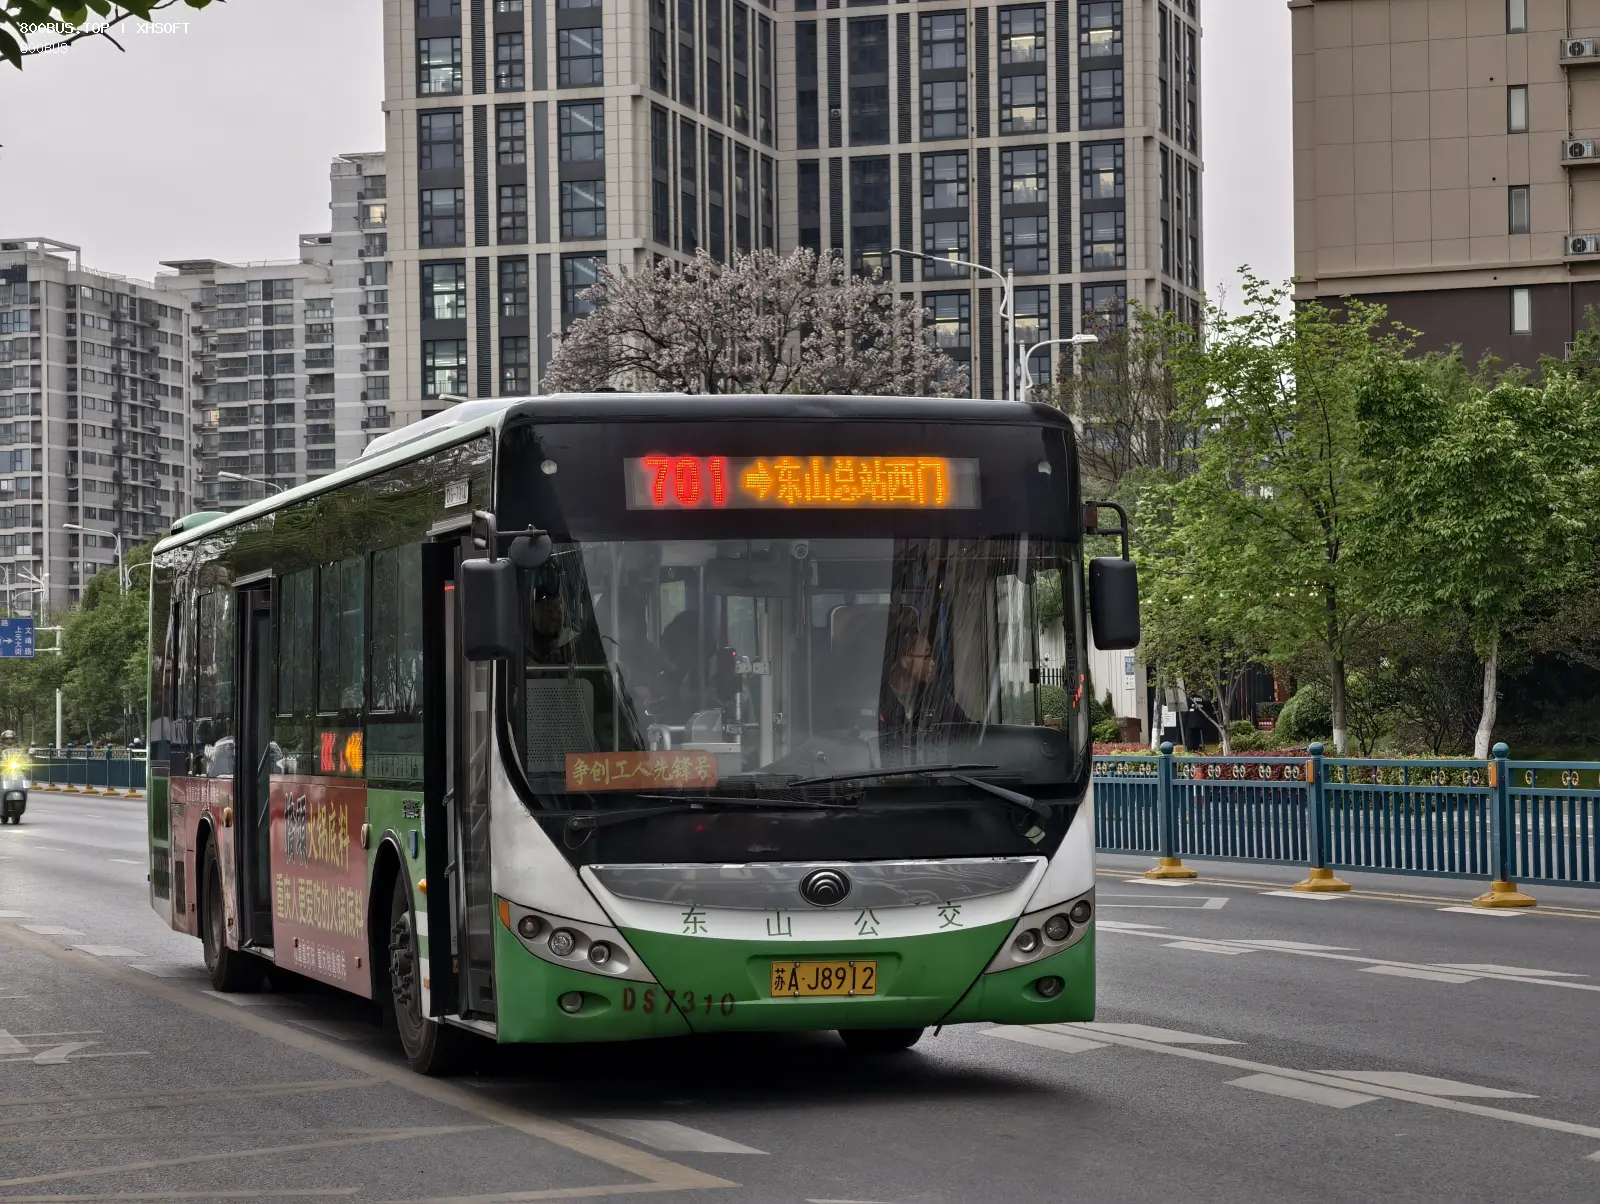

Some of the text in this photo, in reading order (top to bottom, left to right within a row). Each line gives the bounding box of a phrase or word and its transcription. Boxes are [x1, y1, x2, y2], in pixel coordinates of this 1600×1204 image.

[643, 457, 726, 505] 701
[773, 457, 944, 505] 东山总站西门
[681, 901, 964, 938] 东山公交
[622, 986, 736, 1017] DS7310
